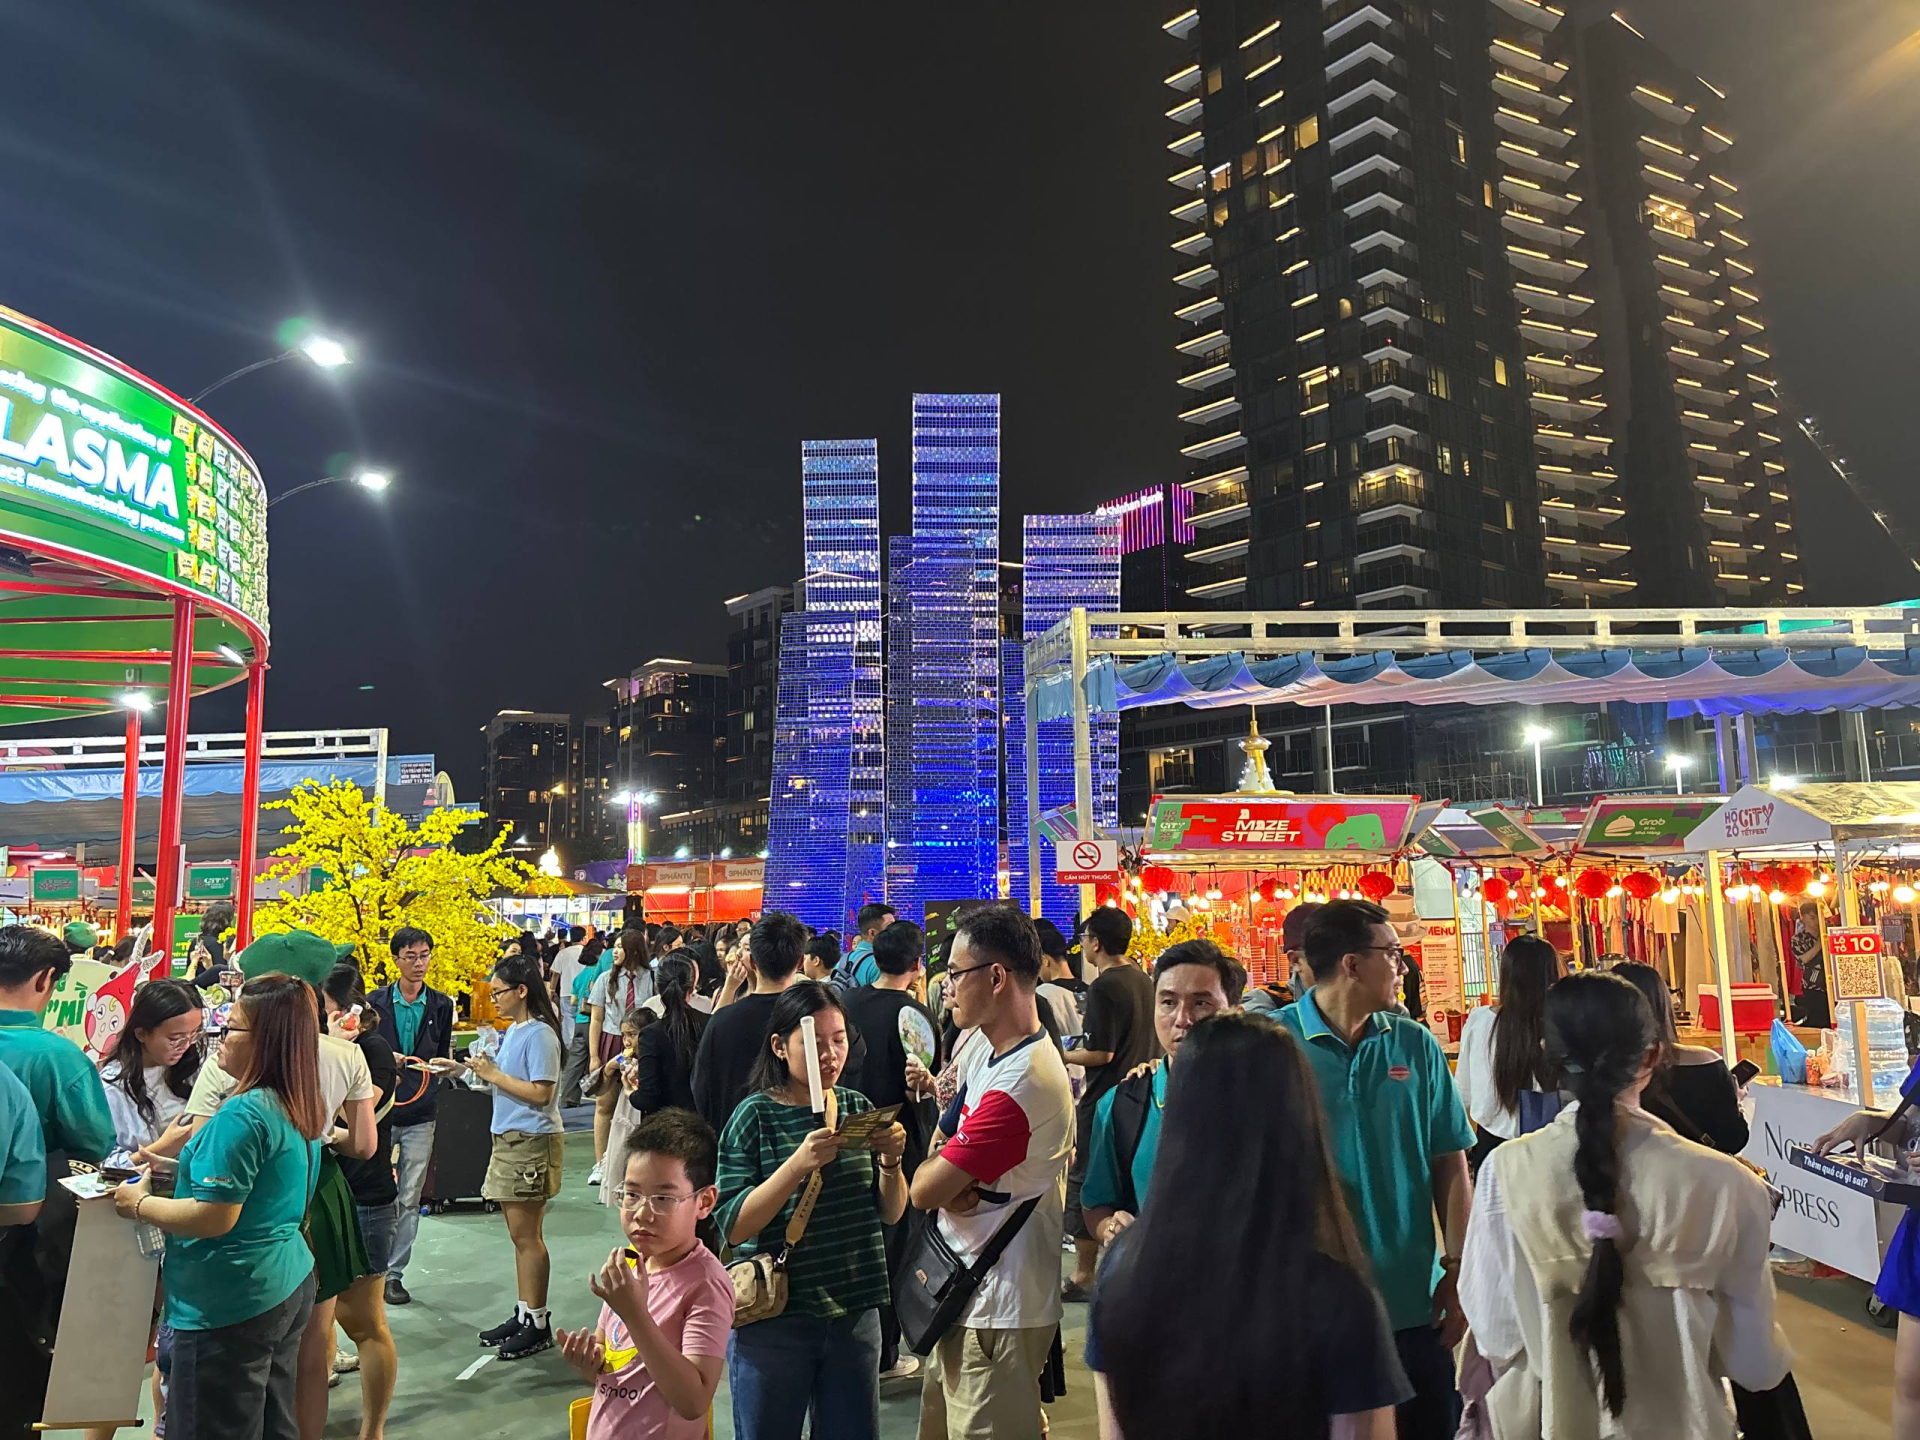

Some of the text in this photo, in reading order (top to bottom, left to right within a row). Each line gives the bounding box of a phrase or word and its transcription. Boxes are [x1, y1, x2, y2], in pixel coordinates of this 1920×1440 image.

[1107, 490, 1164, 515] Shinhan Bank
[1235, 820, 1290, 831] MAZE
[1639, 818, 1666, 826] Grab
[1220, 831, 1301, 842] STREET
[1428, 926, 1456, 936] MENU
[1833, 936, 1846, 944] LÔ
[1850, 937, 1875, 952] 10
[1834, 944, 1847, 952] TÔ
[1835, 1169, 1844, 1179] có
[1844, 1172, 1852, 1184] gì
